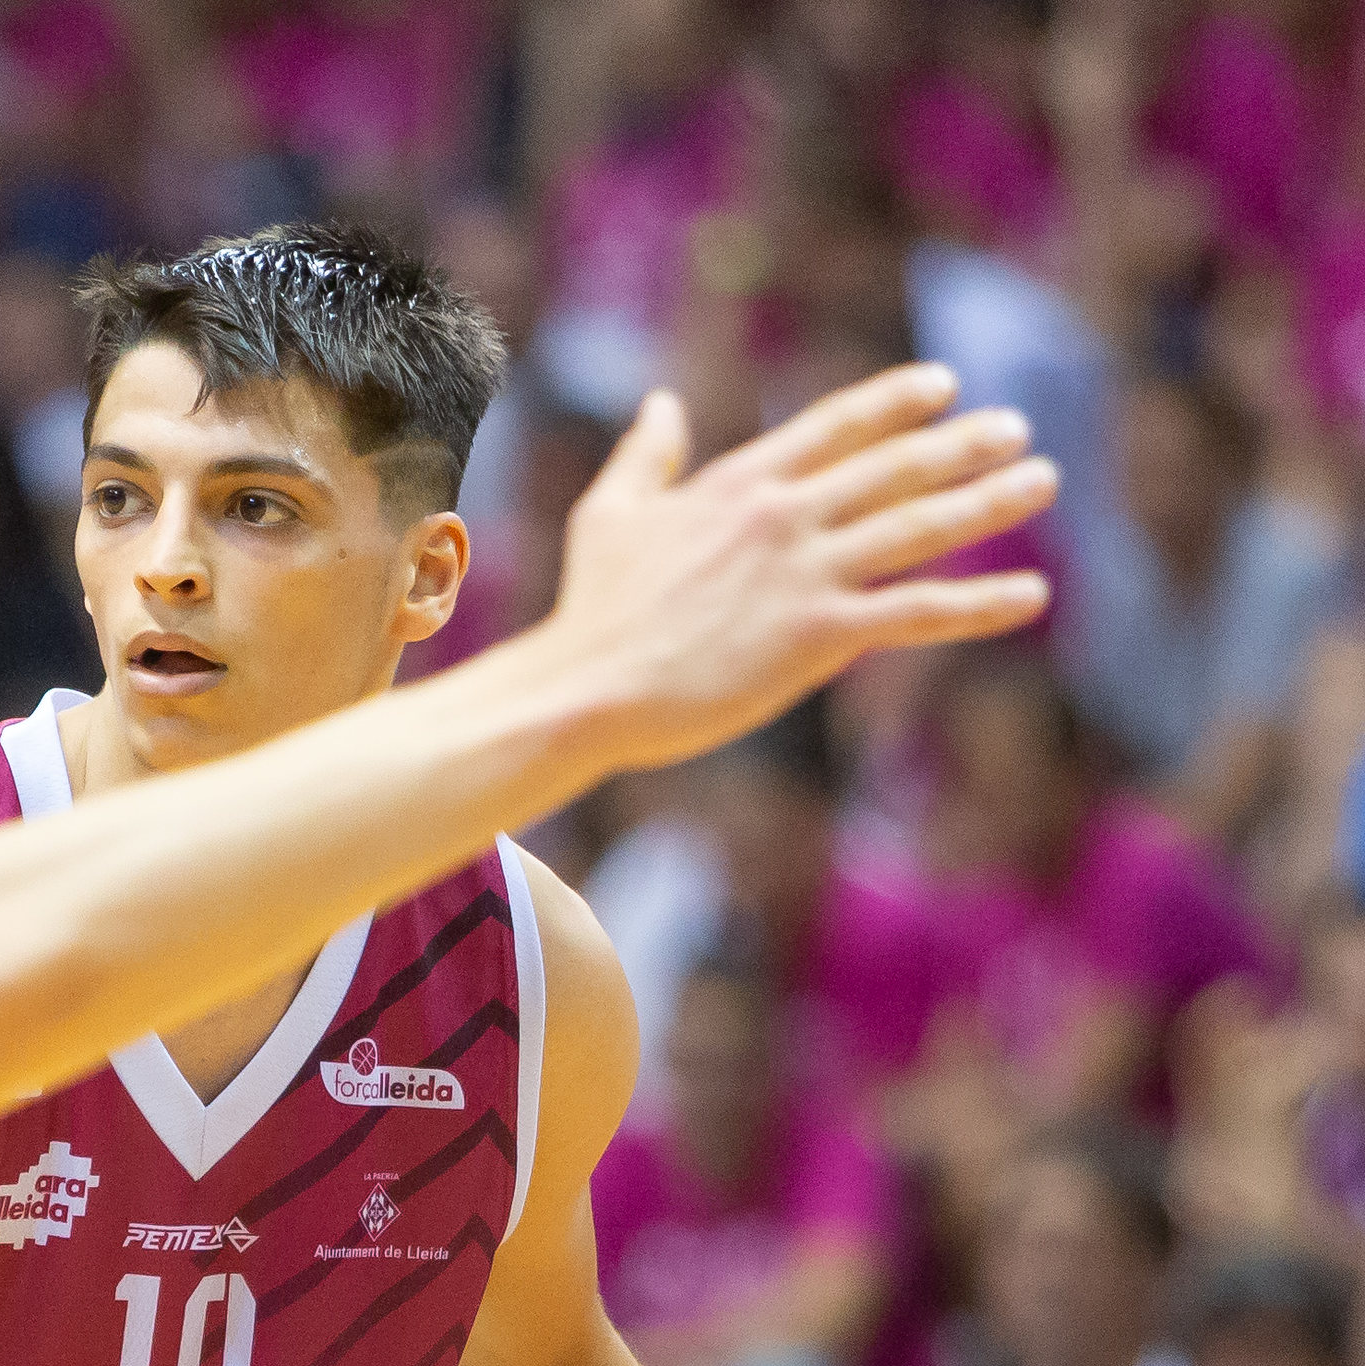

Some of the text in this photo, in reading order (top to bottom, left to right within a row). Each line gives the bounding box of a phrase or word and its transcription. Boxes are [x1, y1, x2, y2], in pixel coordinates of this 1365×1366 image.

[334, 1068, 454, 1102] forçalleida
[34, 1173, 87, 1199] ara
[314, 1244, 450, 1261] Ajuntament de Lleida
